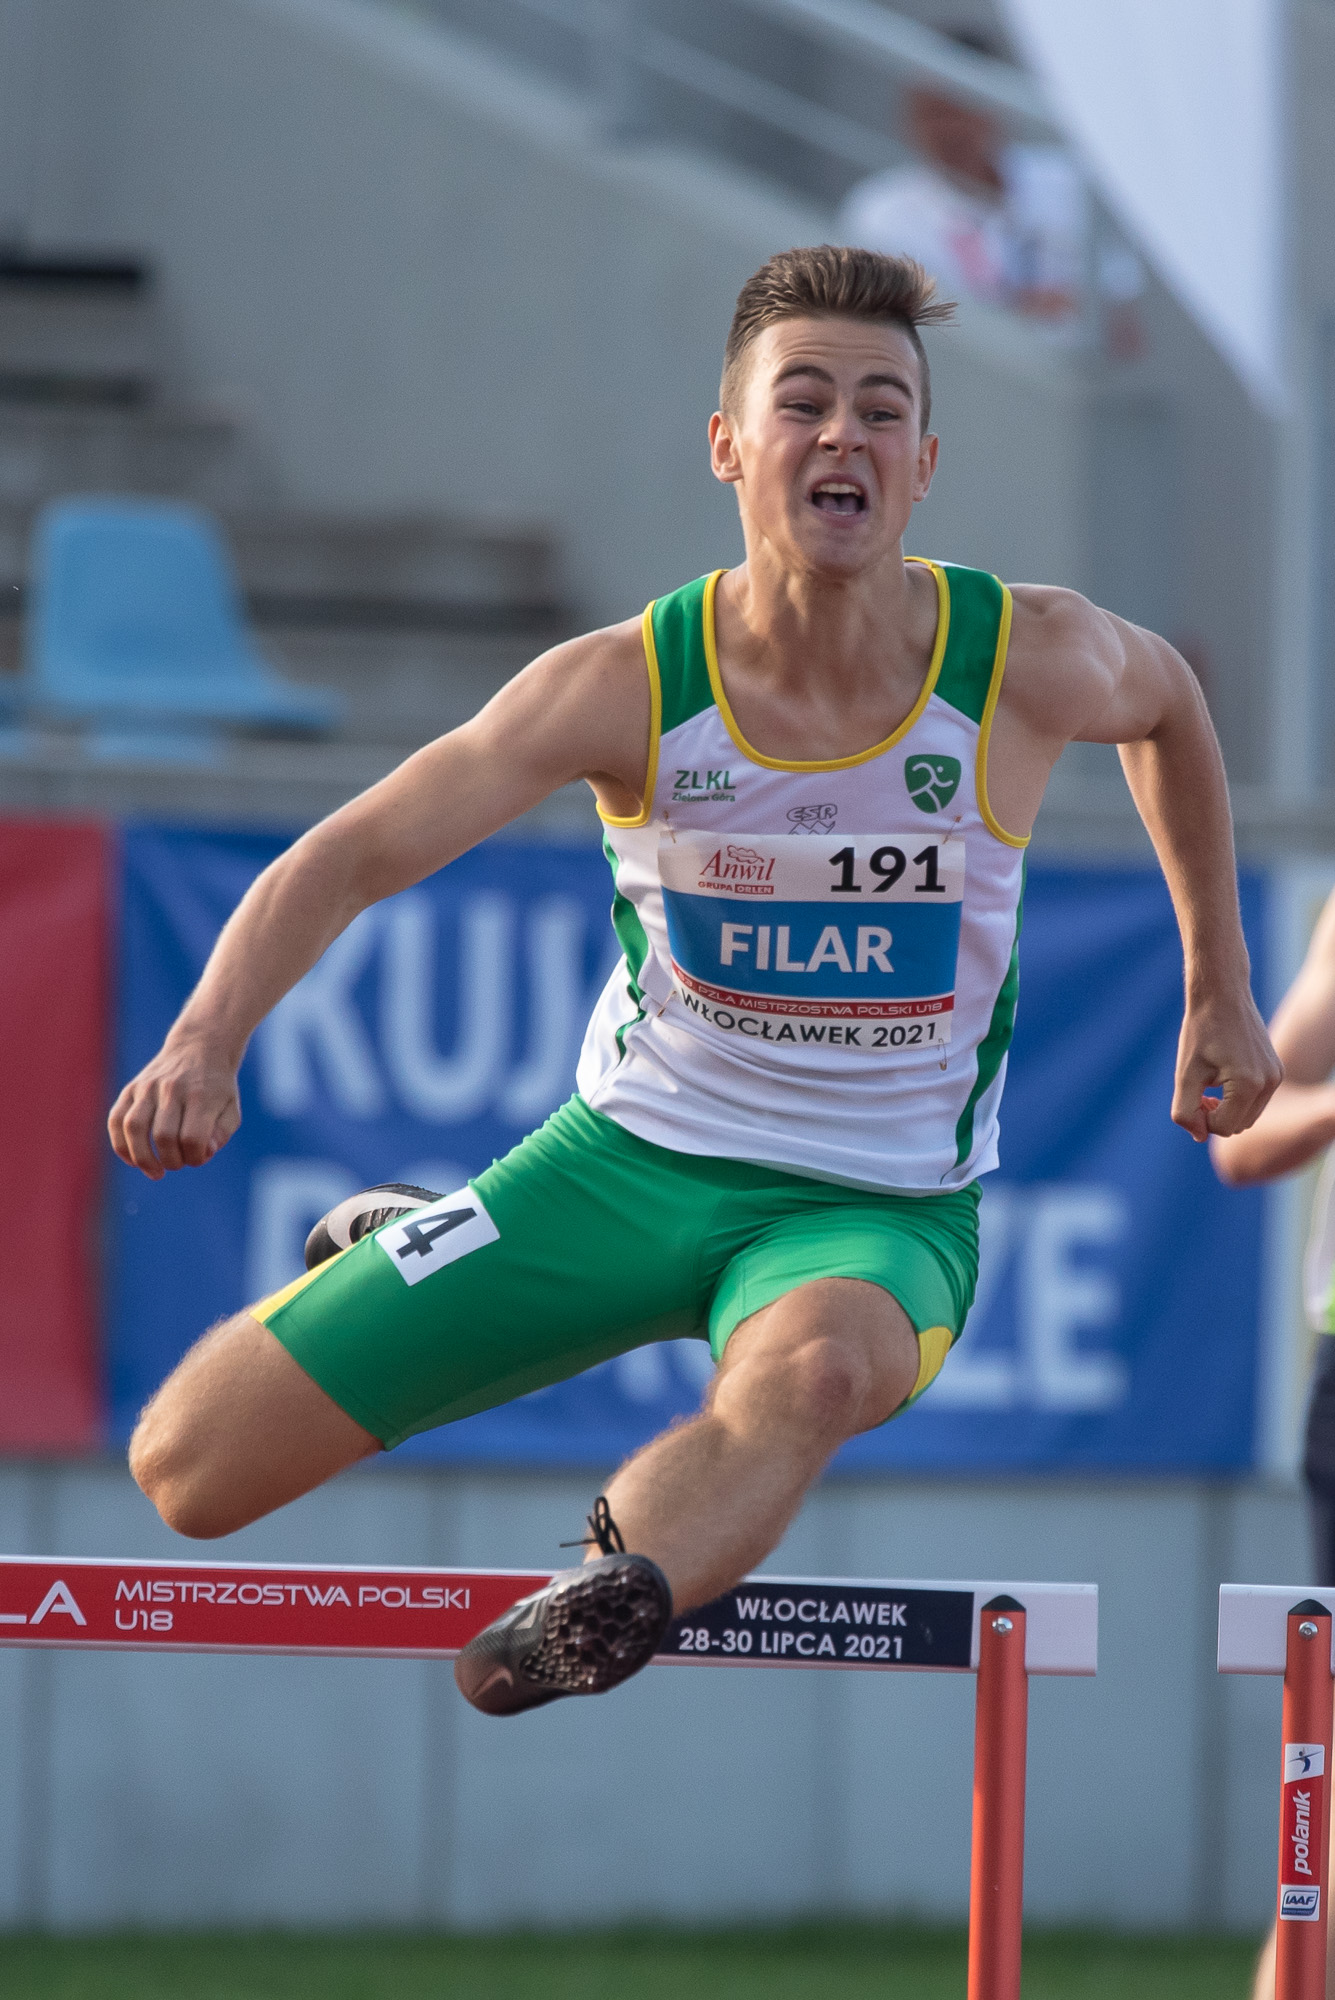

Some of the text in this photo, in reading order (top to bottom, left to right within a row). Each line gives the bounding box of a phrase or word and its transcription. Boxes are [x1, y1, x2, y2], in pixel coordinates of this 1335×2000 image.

[674, 770, 736, 790] ZLKL
[699, 849, 776, 881] Anwil
[828, 845, 946, 893] 191
[698, 881, 772, 894] GRUPA ORLEN
[719, 922, 895, 973] FILAR
[698, 985, 736, 1004] PZLA
[739, 998, 853, 1015] MISTRZOSTWA
[857, 1005, 912, 1016] POLSKI
[916, 1003, 943, 1014] U18
[681, 988, 936, 1048] WŁOCŁAWEK 2021
[396, 1207, 478, 1260] 4
[114, 1579, 471, 1610] MISTRZOSTWA POLSKI
[114, 1608, 174, 1632] U18
[736, 1597, 908, 1627] WŁOCŁAWEK
[679, 1627, 904, 1660] 28-30 LIPCA 2021
[1291, 1789, 1313, 1876] polanik
[1285, 1895, 1316, 1906] IAAF
